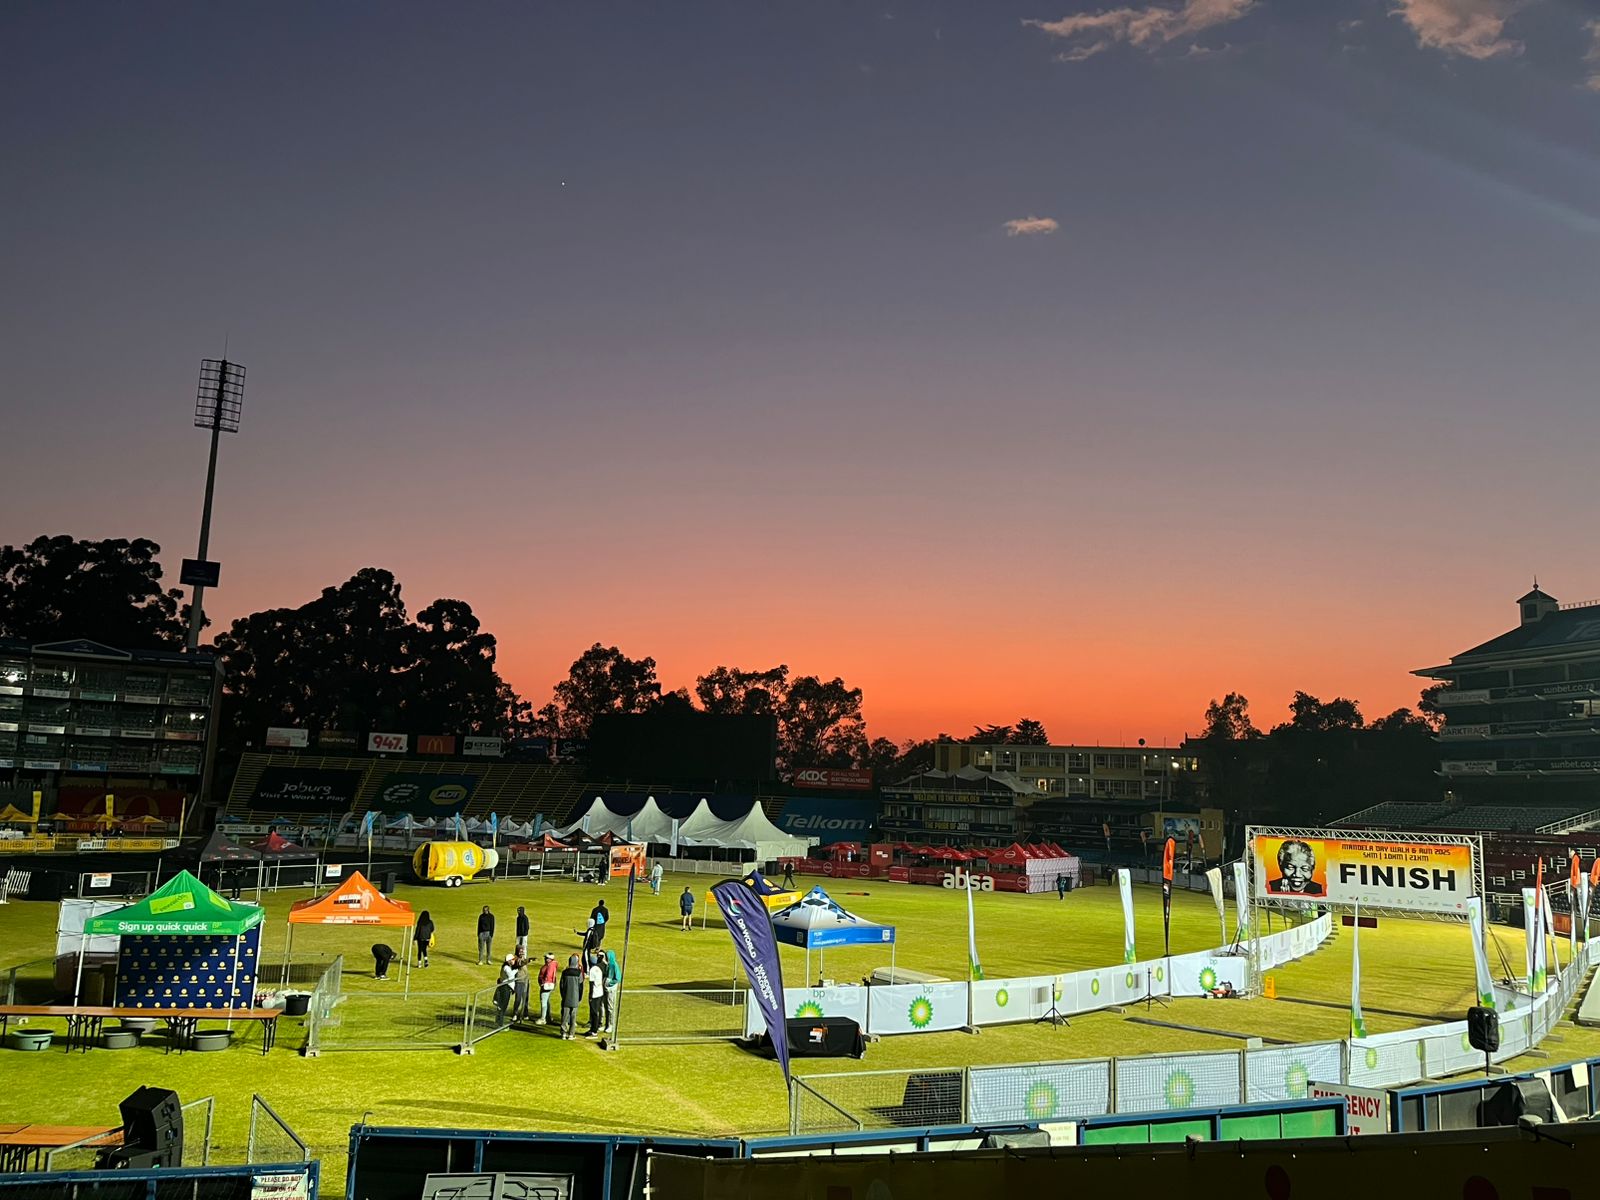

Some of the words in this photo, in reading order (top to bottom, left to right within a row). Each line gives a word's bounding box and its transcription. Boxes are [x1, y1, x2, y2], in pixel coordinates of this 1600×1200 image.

[797, 770, 828, 781] ACDC
[280, 779, 332, 795] Joburg
[437, 789, 460, 799] ADT
[785, 813, 866, 829] Telkom
[1341, 844, 1374, 852] MANDELA
[1390, 845, 1410, 854] WALK
[1434, 848, 1451, 856] 2025
[1409, 854, 1429, 862] 21KM
[943, 866, 995, 892] absa
[1339, 863, 1456, 892] FINISH
[118, 921, 140, 933] Sign
[142, 923, 154, 933] up
[156, 922, 181, 933] quick
[182, 922, 208, 933] quick
[737, 918, 746, 930] DP
[742, 929, 757, 959] WORLD
[758, 963, 779, 1011] WANDERERS
[923, 984, 934, 994] bp
[812, 989, 825, 1000] bp
[1314, 1090, 1381, 1118] GENCY
